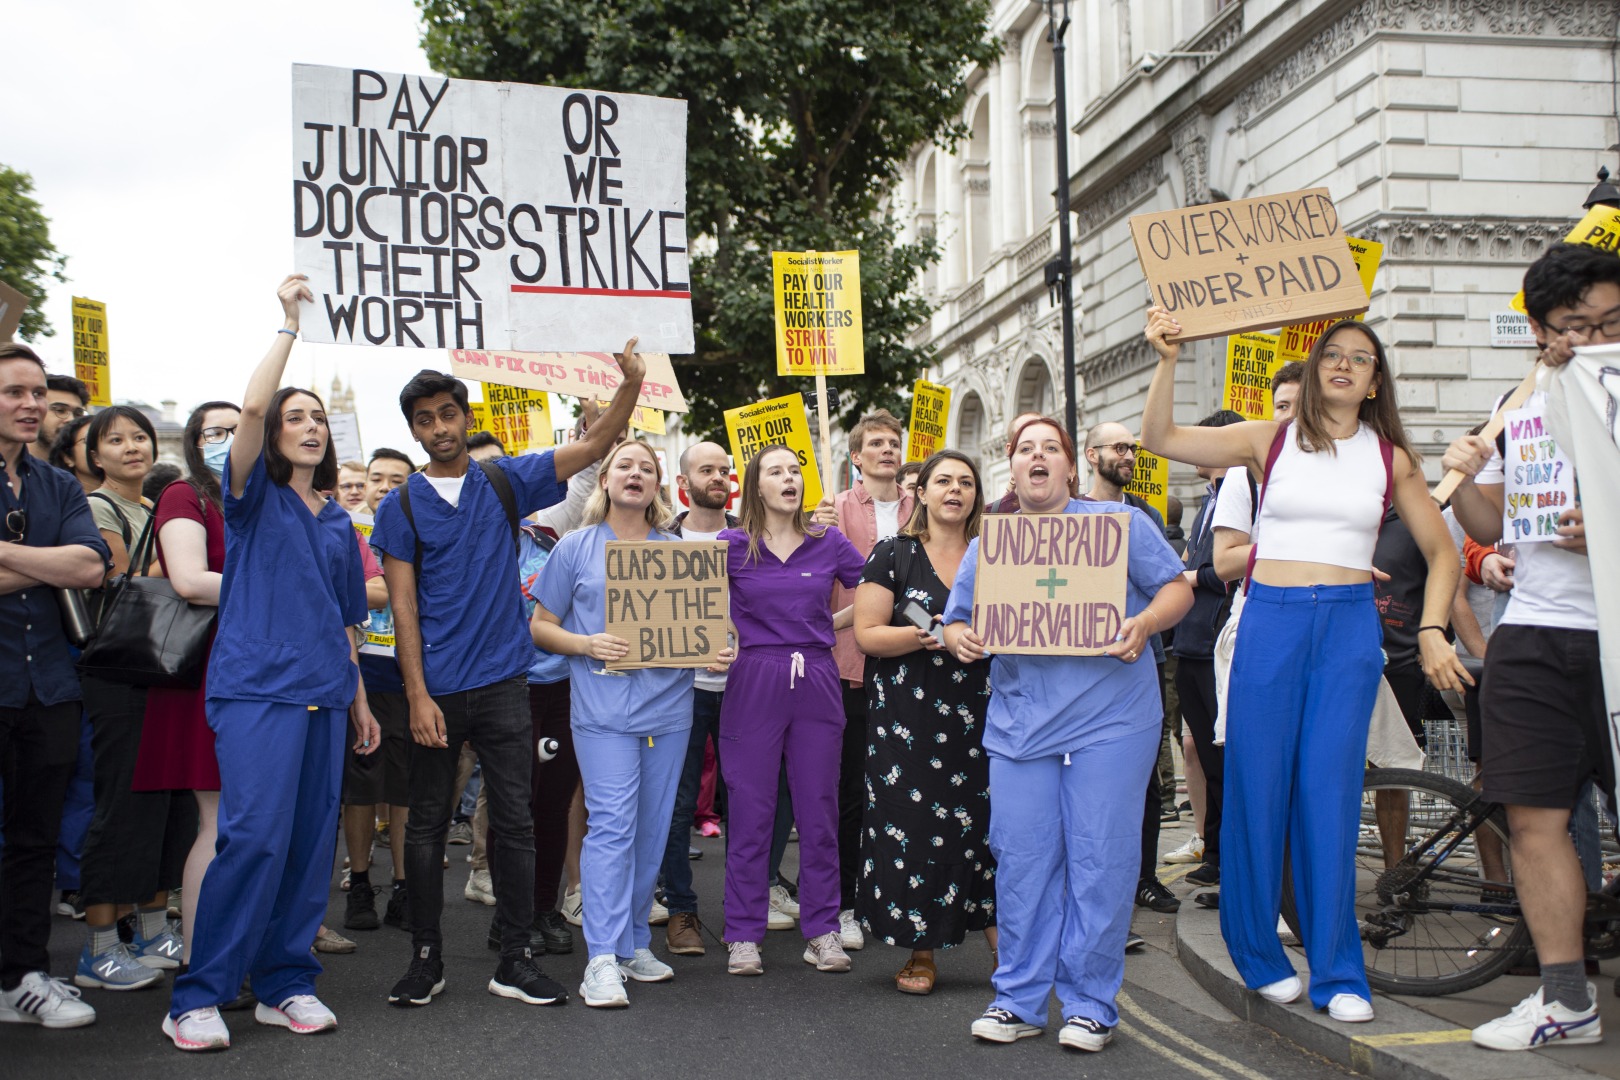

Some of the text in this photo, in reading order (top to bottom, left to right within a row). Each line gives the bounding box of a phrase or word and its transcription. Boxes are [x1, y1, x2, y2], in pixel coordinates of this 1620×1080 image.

[353, 69, 450, 132] PAY
[562, 93, 621, 157] OR
[303, 122, 488, 194] JUNIOR
[564, 155, 623, 206] WE
[294, 180, 505, 251] DOCTORS
[508, 203, 690, 291] STRIKE
[322, 241, 482, 301] THEIR
[783, 273, 843, 291] PAY OUR
[784, 292, 834, 309] HEALTH
[784, 310, 853, 328] WORKERS
[1242, 302, 1274, 319] NHS
[1496, 315, 1530, 324] DOWNIN
[323, 294, 484, 350] WORTH
[1497, 326, 1527, 335] STREET
[786, 329, 835, 346] STRIKE
[1286, 331, 1299, 351] TO
[786, 348, 837, 365] TO WIN
[1234, 344, 1252, 358] PAY
[1256, 348, 1274, 363] OUR
[76, 364, 98, 381] TRIKE
[1233, 358, 1267, 375] HEALTH
[494, 355, 526, 373] FIX
[529, 361, 567, 380] CUTS
[574, 367, 619, 388] THIS
[640, 381, 673, 398] EEP
[1231, 371, 1272, 390] WORKER
[489, 387, 528, 402] HEALTH
[917, 393, 930, 408] PAY
[932, 398, 943, 412] OUR
[1230, 385, 1264, 402] STRIKE
[490, 399, 543, 416] WORKERS
[916, 407, 939, 423] HEALTH
[1230, 399, 1264, 416] TO WIN
[473, 418, 484, 430] AY
[493, 414, 531, 431] STRIKE
[737, 417, 793, 444] PAY OUR
[914, 419, 943, 438] WORKERS
[1510, 416, 1549, 440] WAN
[494, 431, 508, 444] TO
[512, 428, 534, 442] WIN
[913, 432, 935, 448] STRIKE
[912, 444, 920, 458] TO
[1520, 440, 1556, 462] US TO
[1138, 456, 1158, 470] OUR
[1514, 461, 1563, 485] STAY?
[1507, 493, 1534, 519] YOU
[1511, 518, 1531, 539] TO
[982, 515, 1122, 567] UNDERPAID
[607, 545, 727, 581] CLAPS DON'T
[608, 587, 723, 623] PAY THE
[974, 601, 1122, 649] UNDERVALUED
[640, 625, 710, 662] BILLS
